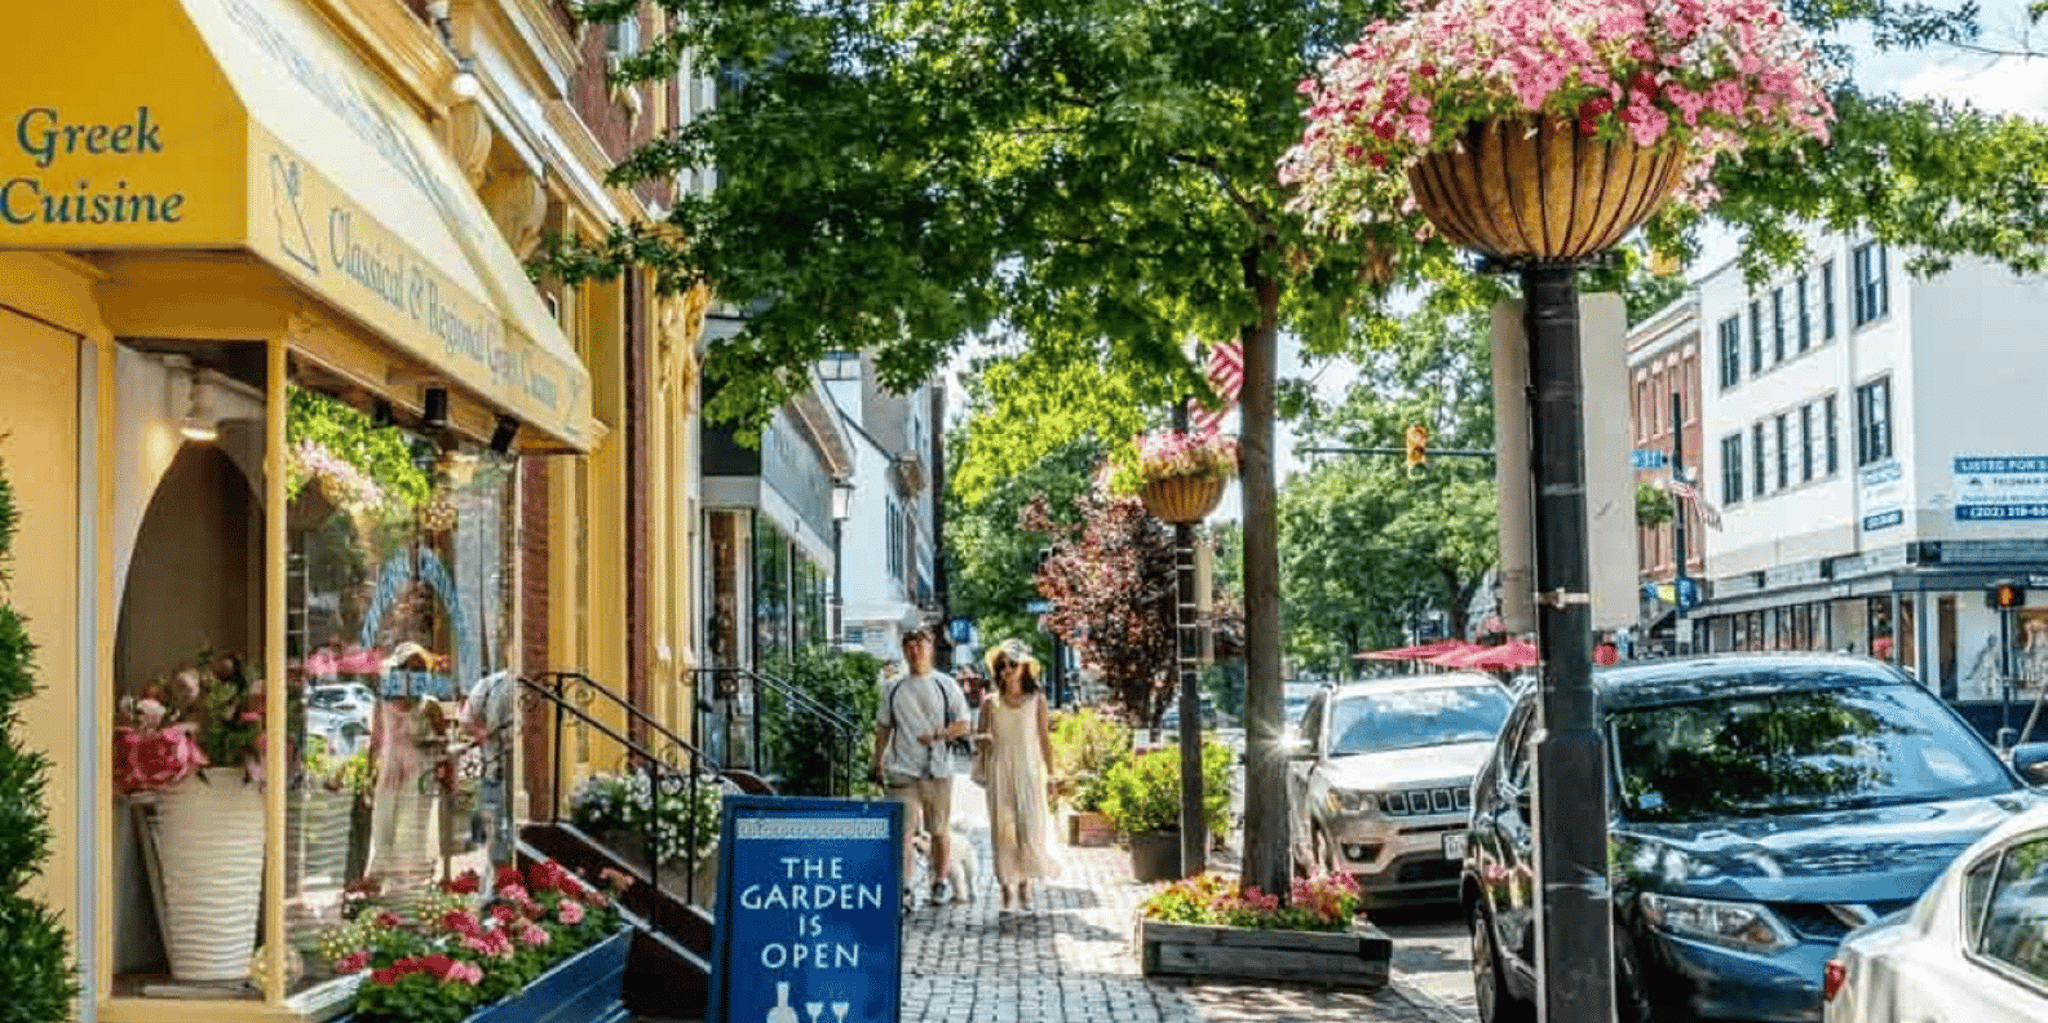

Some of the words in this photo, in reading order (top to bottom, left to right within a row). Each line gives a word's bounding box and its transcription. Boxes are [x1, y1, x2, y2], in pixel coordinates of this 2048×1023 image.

[17, 106, 164, 168] Greek
[0, 178, 185, 225] Cuisine
[329, 206, 404, 311] Classical
[409, 264, 423, 319] &
[780, 857, 844, 879] THE
[740, 884, 882, 910] GARDEN
[799, 914, 823, 937] IS
[761, 943, 860, 969] OPEN
